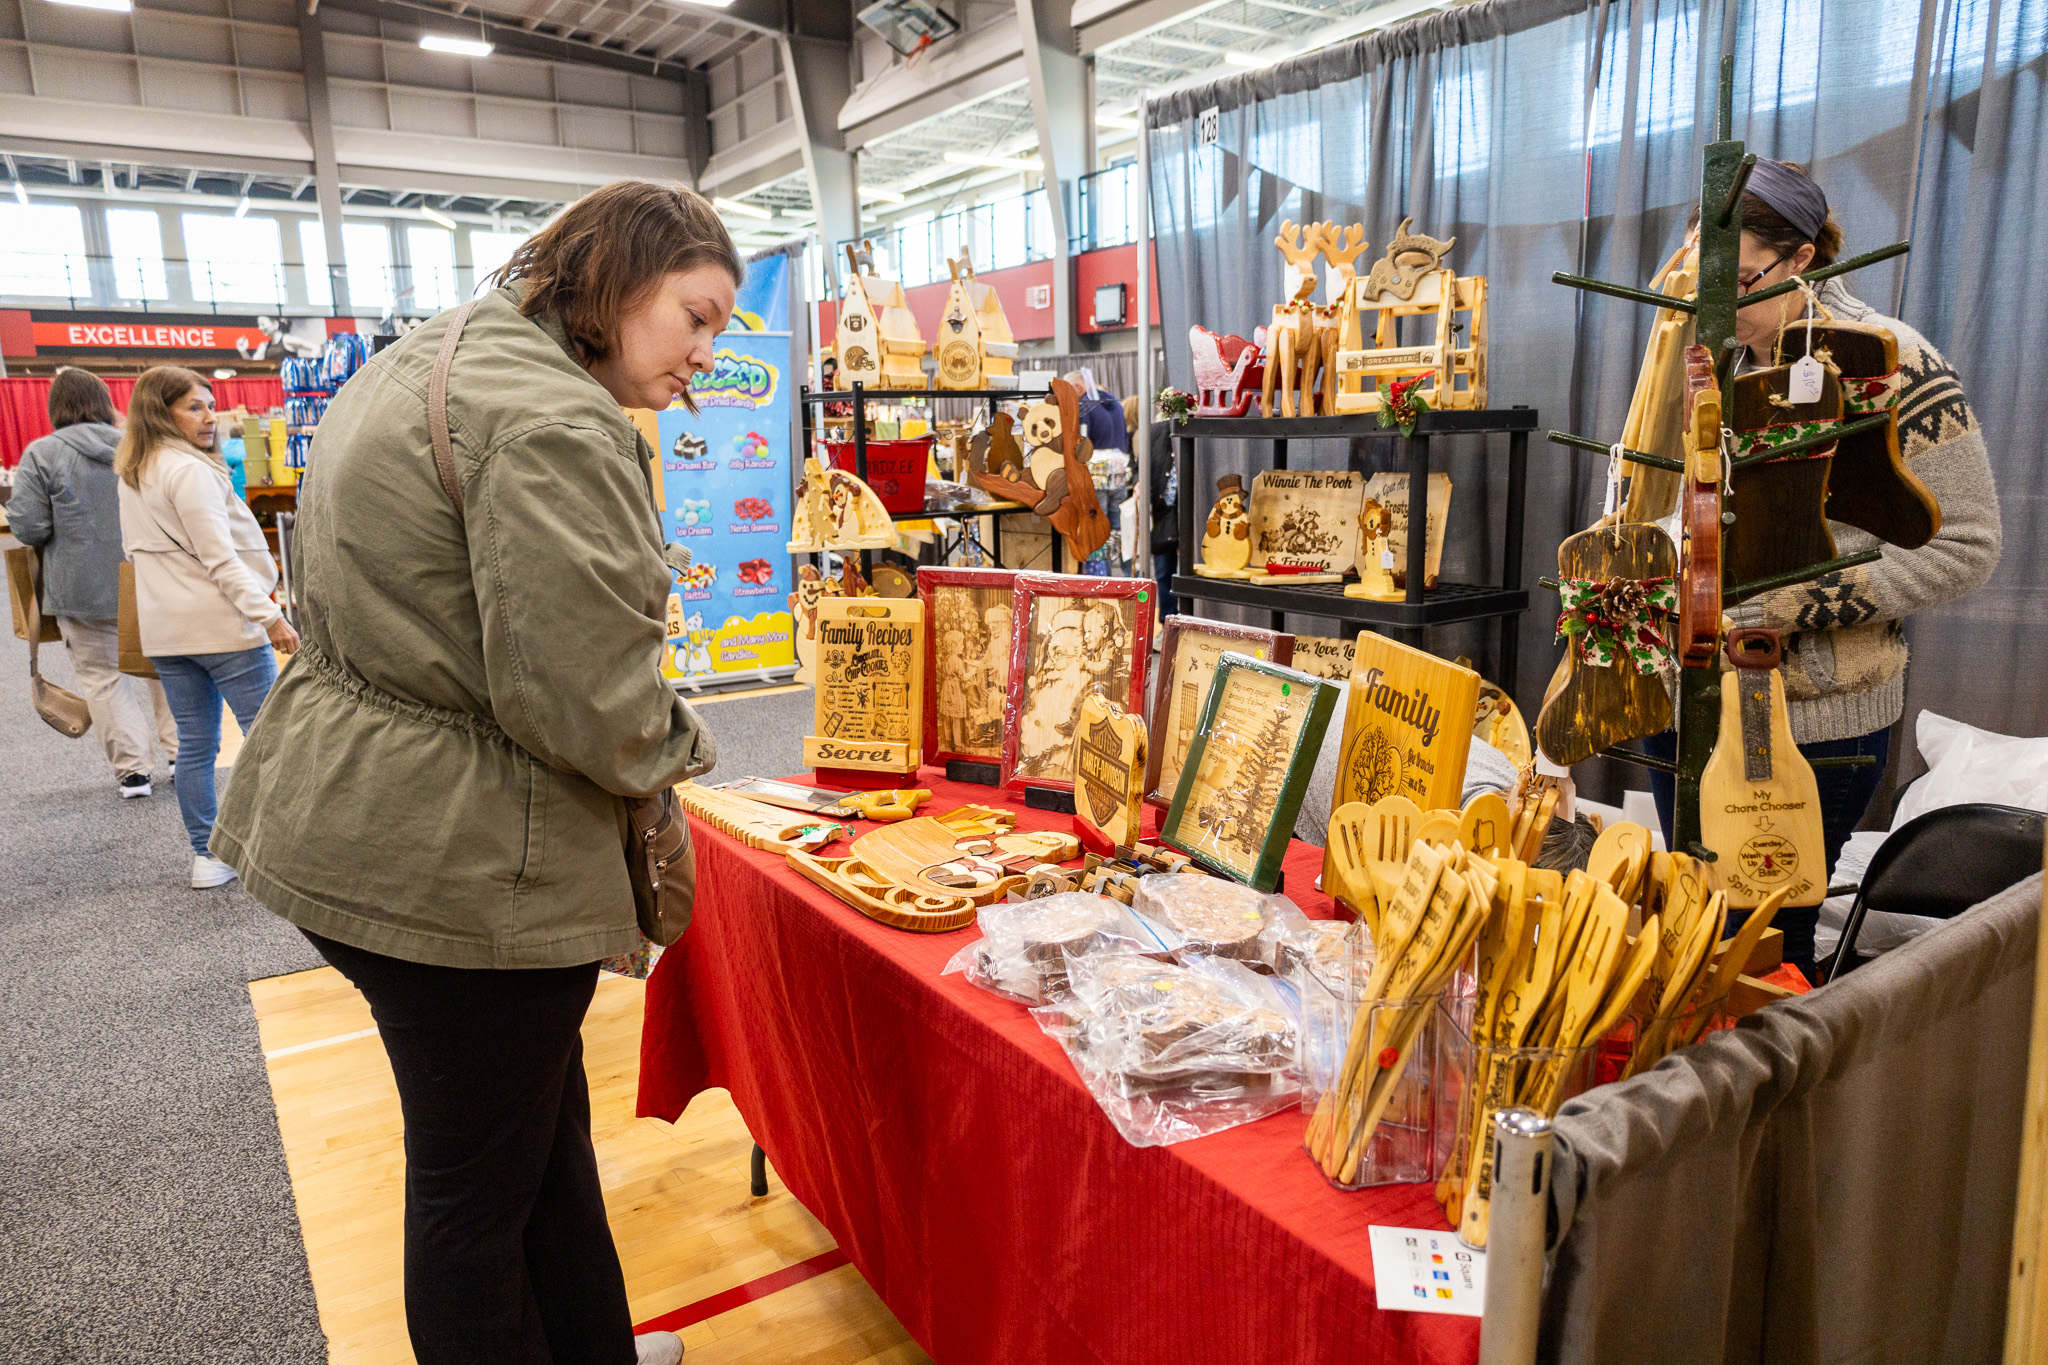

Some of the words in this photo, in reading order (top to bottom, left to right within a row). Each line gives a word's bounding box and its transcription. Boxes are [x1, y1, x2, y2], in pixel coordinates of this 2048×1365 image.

[1201, 114, 1217, 145] 128
[68, 325, 217, 348] EXCELLENCE
[709, 395, 731, 407] Dried
[730, 396, 756, 411] Candy
[665, 460, 676, 471] Ice
[677, 460, 702, 471] Cream
[702, 459, 717, 470] Bar
[728, 459, 744, 471] Jolly
[744, 457, 776, 469] Rancher
[1263, 475, 1301, 489] Winnie
[1303, 475, 1323, 489] The
[1325, 475, 1353, 489] Pooh
[676, 526, 687, 537] Ice
[687, 526, 713, 536] Cream
[730, 524, 750, 534] Nerds
[750, 523, 779, 534] Gummy
[1281, 556, 1331, 570] Friends
[683, 590, 712, 601] Skittles
[733, 585, 779, 597] Strawberries
[720, 636, 737, 648] and
[738, 634, 765, 646] Many
[766, 631, 789, 643] More
[820, 620, 865, 652] Family
[866, 621, 913, 653] Recipes
[1294, 639, 1310, 655] ive,
[1313, 641, 1340, 658] Love,
[844, 665, 861, 683] CHIP
[860, 659, 889, 677] COOKIES
[1365, 667, 1440, 748] Family
[817, 743, 892, 763] Secret
[1081, 748, 1126, 795] HARLEY-DAVIDSON
[1753, 790, 1772, 800] My
[1724, 804, 1758, 814] Chore
[1760, 801, 1806, 812] Chooser
[1753, 840, 1782, 848] Exercise
[1741, 852, 1761, 860] Wash
[1727, 874, 1754, 898] Spin
[1787, 878, 1815, 900] Dial
[1460, 1262, 1473, 1289] Square
